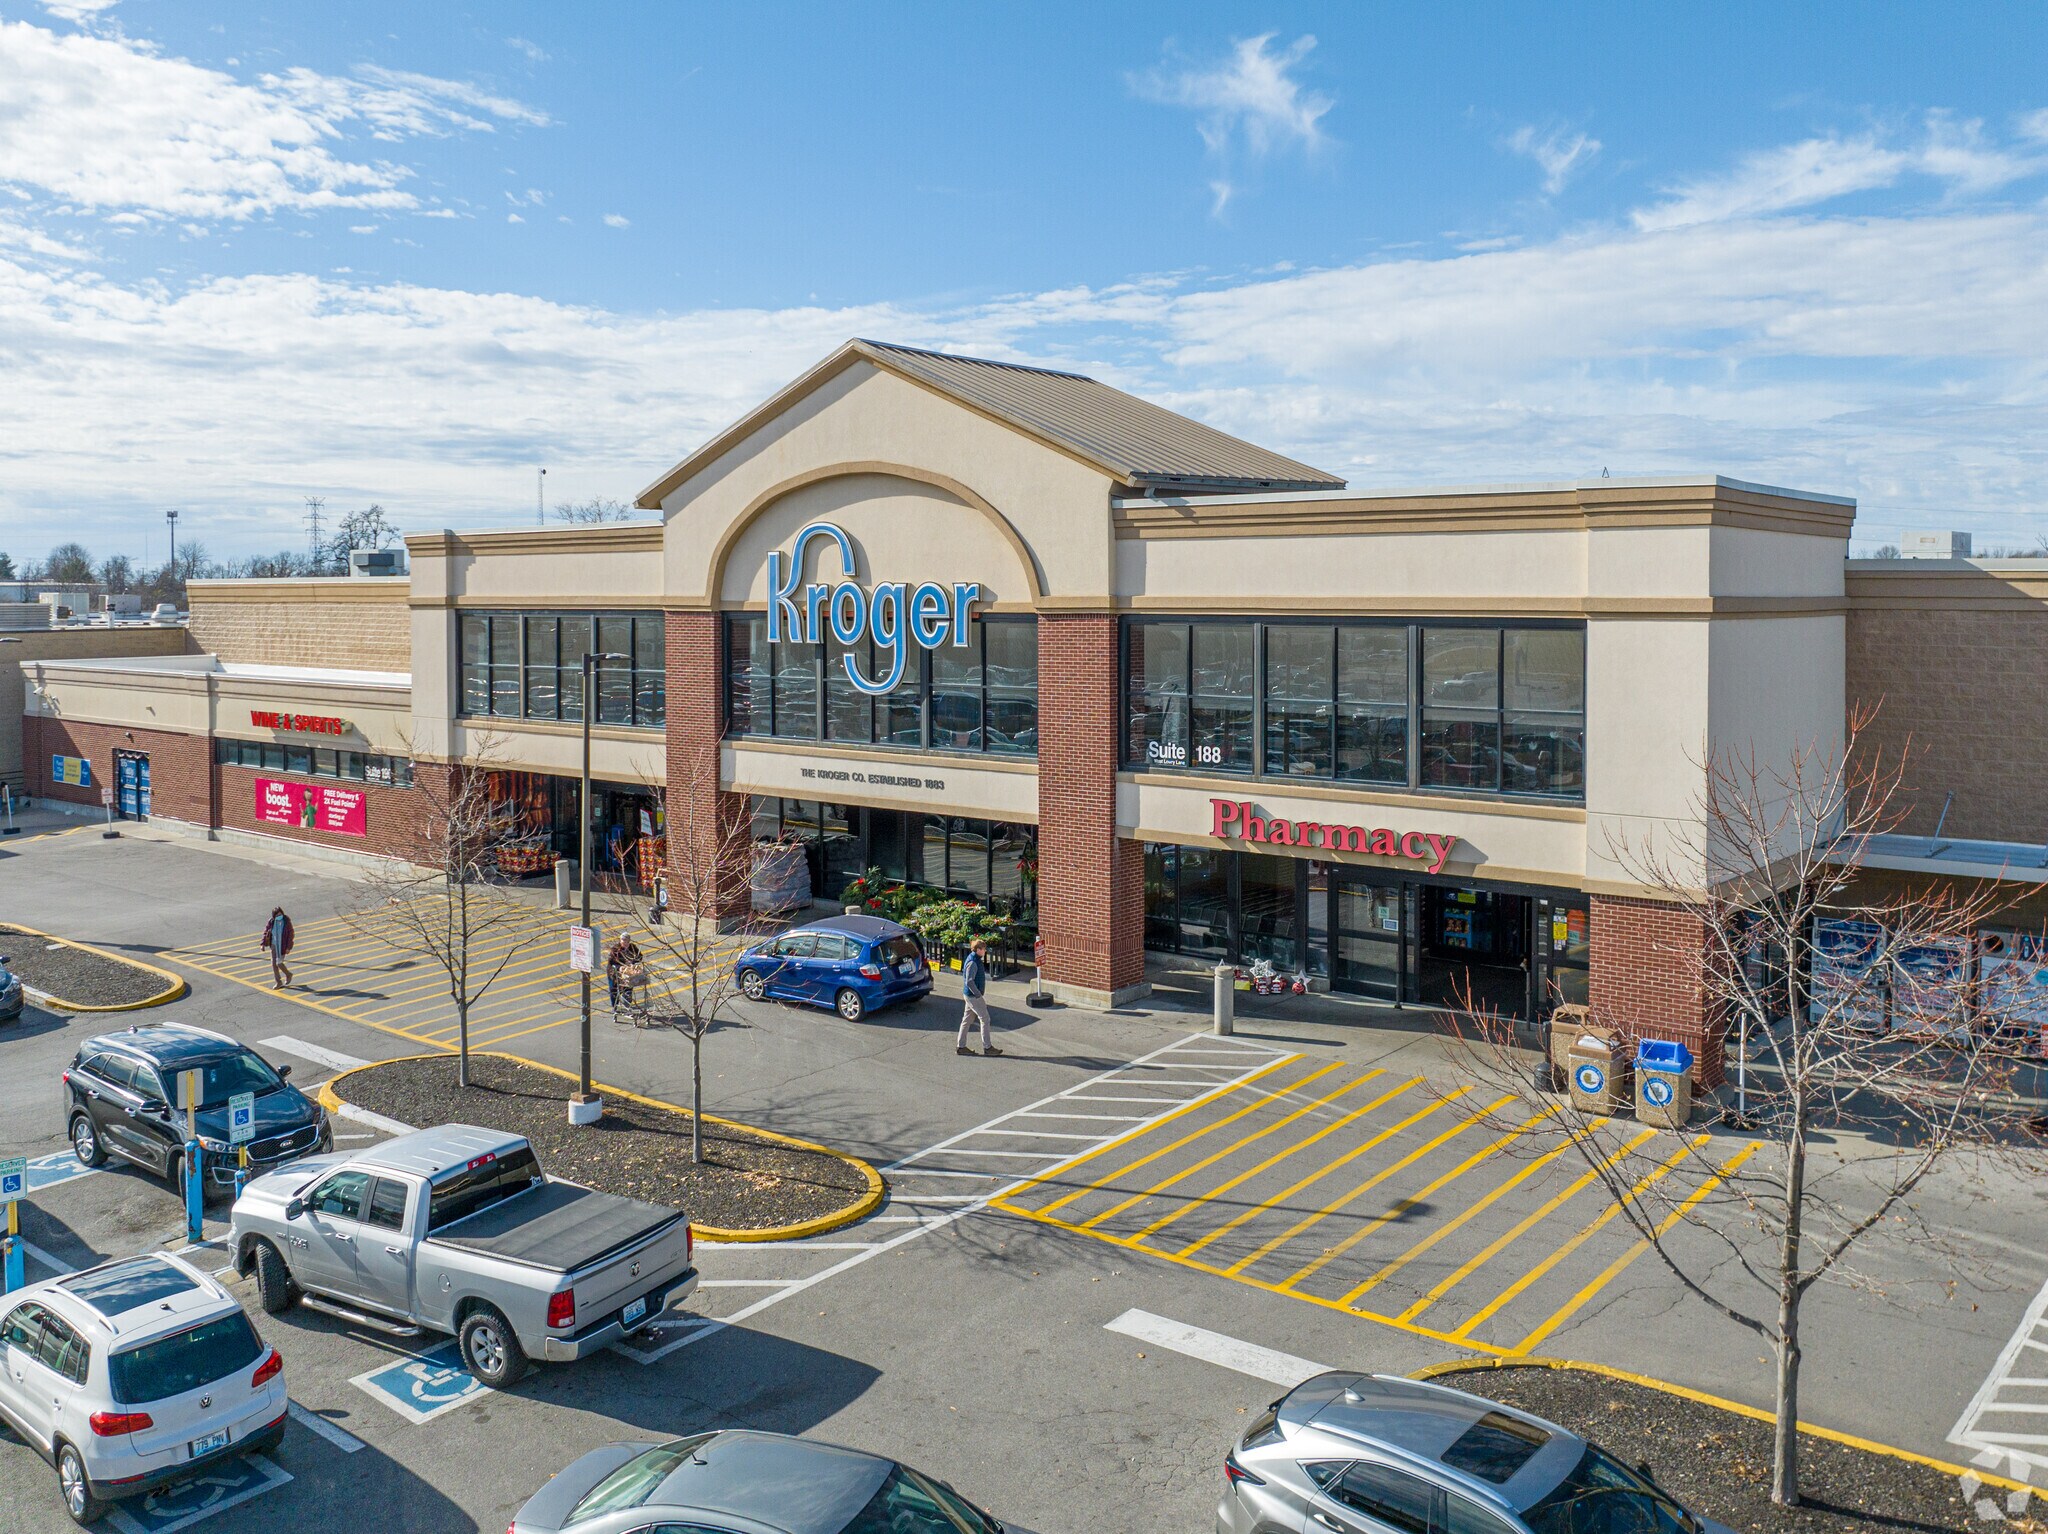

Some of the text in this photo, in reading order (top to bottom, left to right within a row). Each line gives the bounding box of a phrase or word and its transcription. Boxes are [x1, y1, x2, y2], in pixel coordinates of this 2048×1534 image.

[767, 522, 981, 696] Kroger
[250, 710, 343, 736] WINE & SPIRITS
[1149, 740, 1222, 764] Suite 188
[800, 767, 945, 790] THE KROGER CO. ESTABLISHED 1883
[270, 782, 285, 793] NEW
[323, 789, 336, 799] FREE
[336, 790, 355, 801] Delivery
[323, 797, 331, 805] 2X
[330, 798, 341, 807] Fuel
[1209, 798, 1457, 875] Pharmacy
[573, 929, 590, 938] NOTICE
[230, 1094, 253, 1104] RESERVED
[232, 1101, 251, 1109] PARKING
